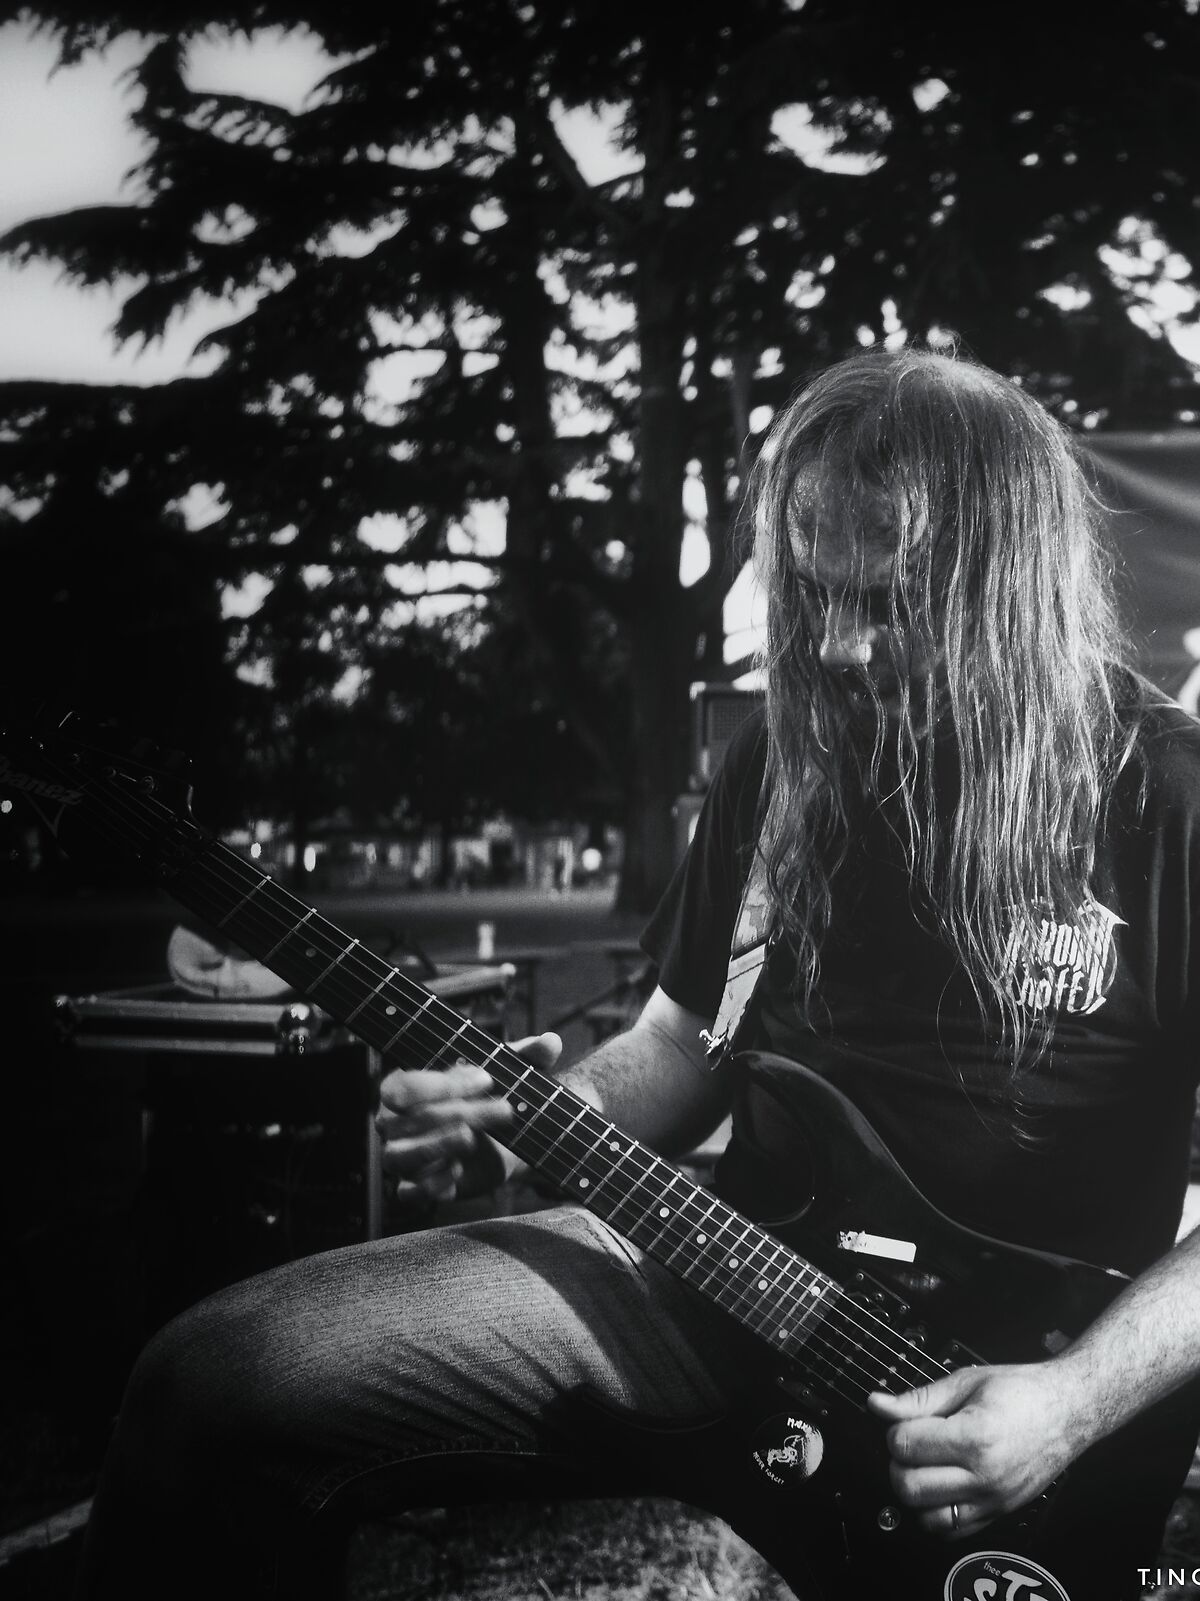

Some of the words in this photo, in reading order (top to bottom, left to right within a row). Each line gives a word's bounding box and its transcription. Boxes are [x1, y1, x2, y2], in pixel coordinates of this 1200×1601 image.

[764, 1468, 785, 1485] FORGET
[983, 1561, 1001, 1577] thee
[963, 1569, 1049, 1601] ST
